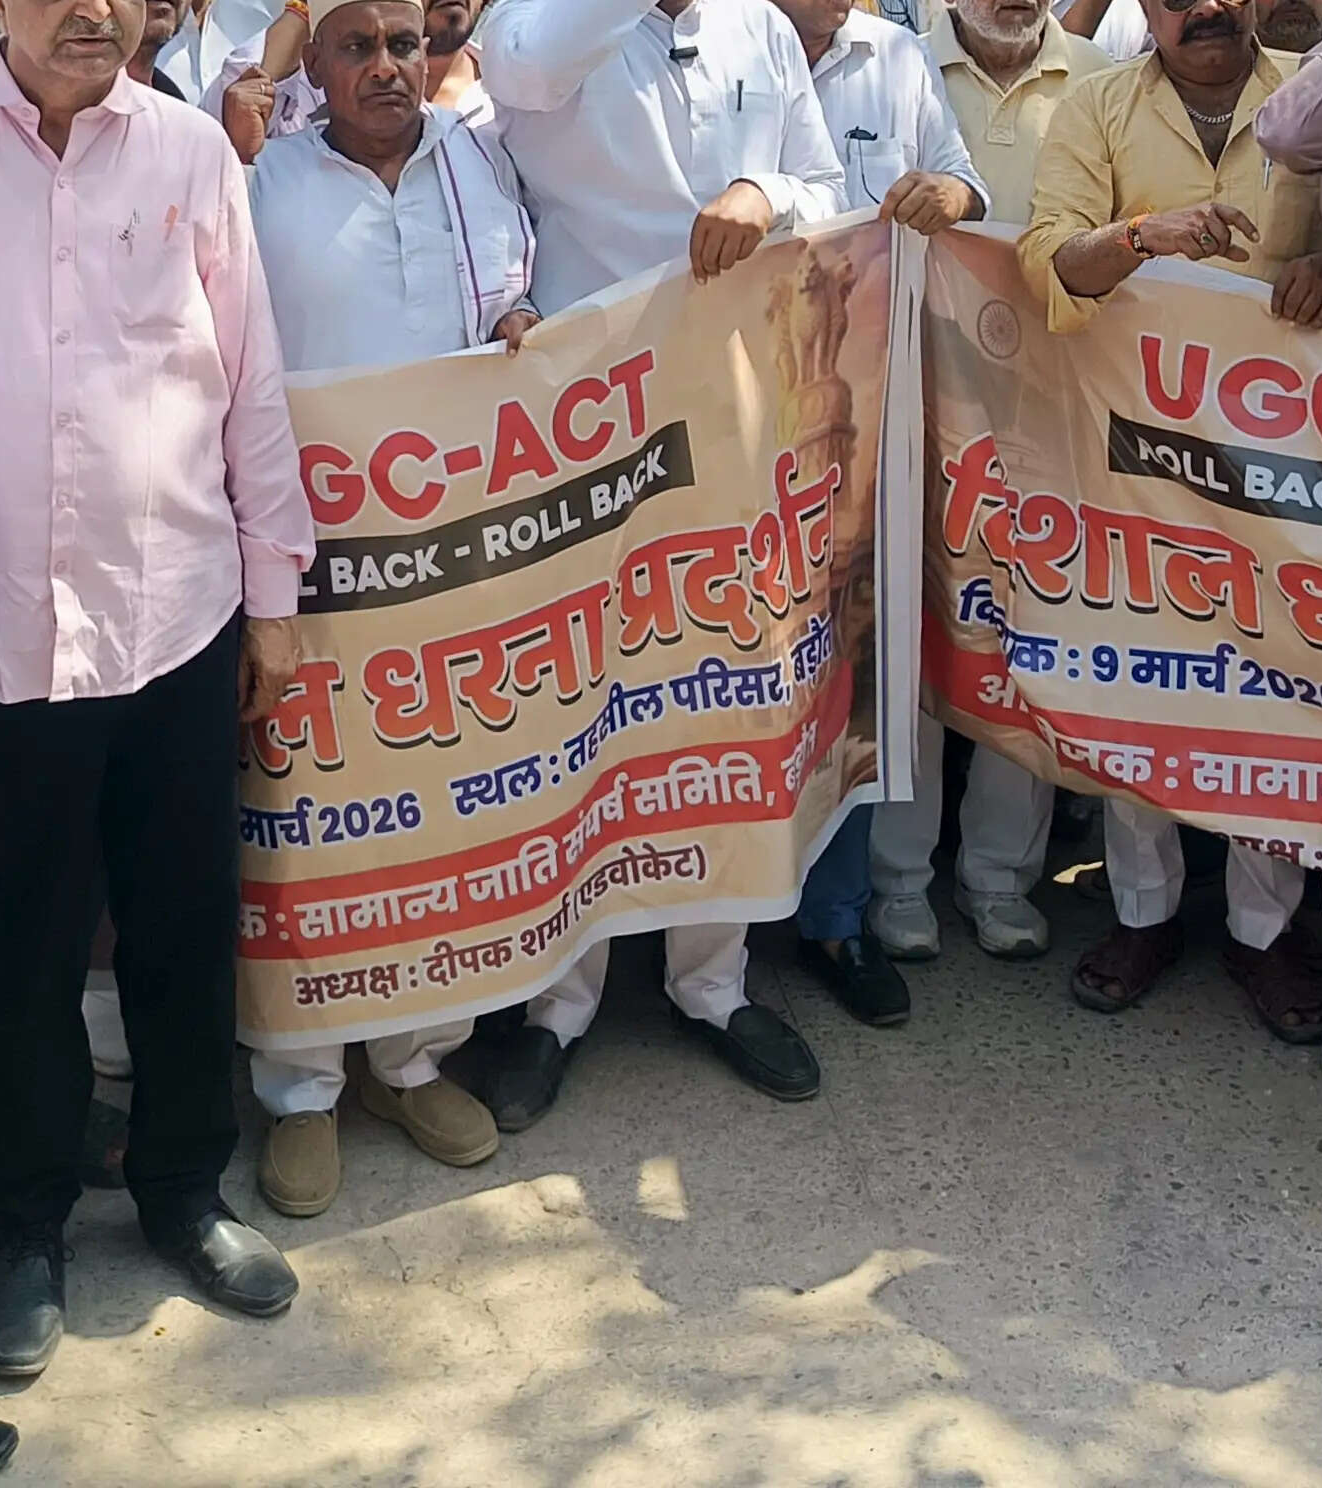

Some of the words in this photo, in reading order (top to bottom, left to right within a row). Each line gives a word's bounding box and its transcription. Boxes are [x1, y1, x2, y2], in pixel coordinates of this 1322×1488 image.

[299, 349, 655, 526] GC-ACT
[329, 543, 444, 595] BACK
[481, 499, 583, 564] ROLL
[589, 444, 667, 520] BACK
[362, 581, 610, 747] धरना
[617, 451, 841, 653] प्रदर्शन
[1093, 645, 1119, 682] 9
[1130, 643, 1236, 694] मार्च
[240, 796, 314, 848] मार्च
[317, 792, 422, 844] 2026
[450, 754, 540, 817] स्थल
[563, 681, 664, 774] तहसील
[669, 657, 792, 714] परिसर,
[292, 874, 460, 941] सामान्य
[464, 834, 559, 903] जाति
[562, 771, 630, 865] संघर्ष
[630, 751, 776, 816] समिति,
[295, 962, 398, 1009] अध्यक्ष
[424, 937, 513, 990] दीपक
[521, 892, 572, 957] शर्मा
[574, 842, 707, 922] (एडवोकेट)
